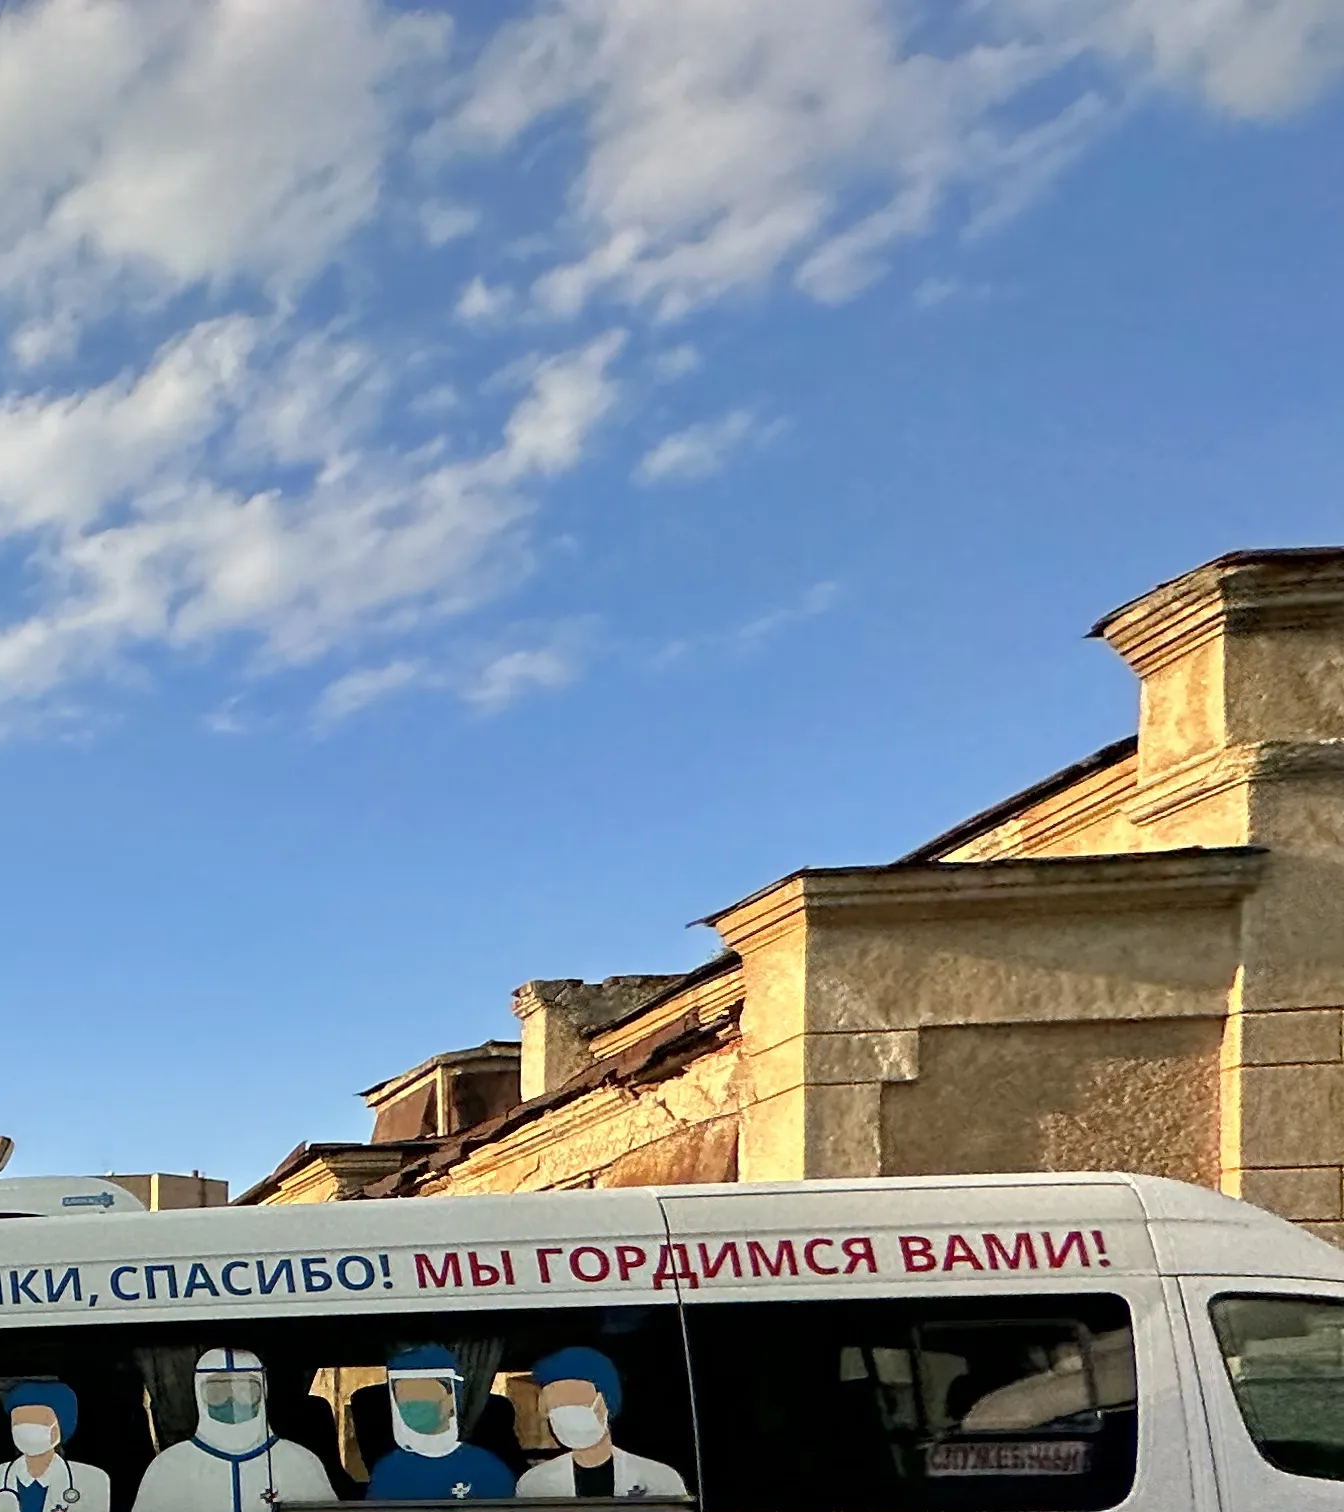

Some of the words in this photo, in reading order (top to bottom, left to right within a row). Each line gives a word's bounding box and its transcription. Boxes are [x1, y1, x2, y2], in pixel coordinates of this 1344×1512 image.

[109, 1253, 394, 1302] СПАСИБО!
[413, 1248, 515, 1290] МЫ
[535, 1236, 878, 1290] ГОРДИМСЯ
[897, 1229, 1112, 1273] ВАМИ!
